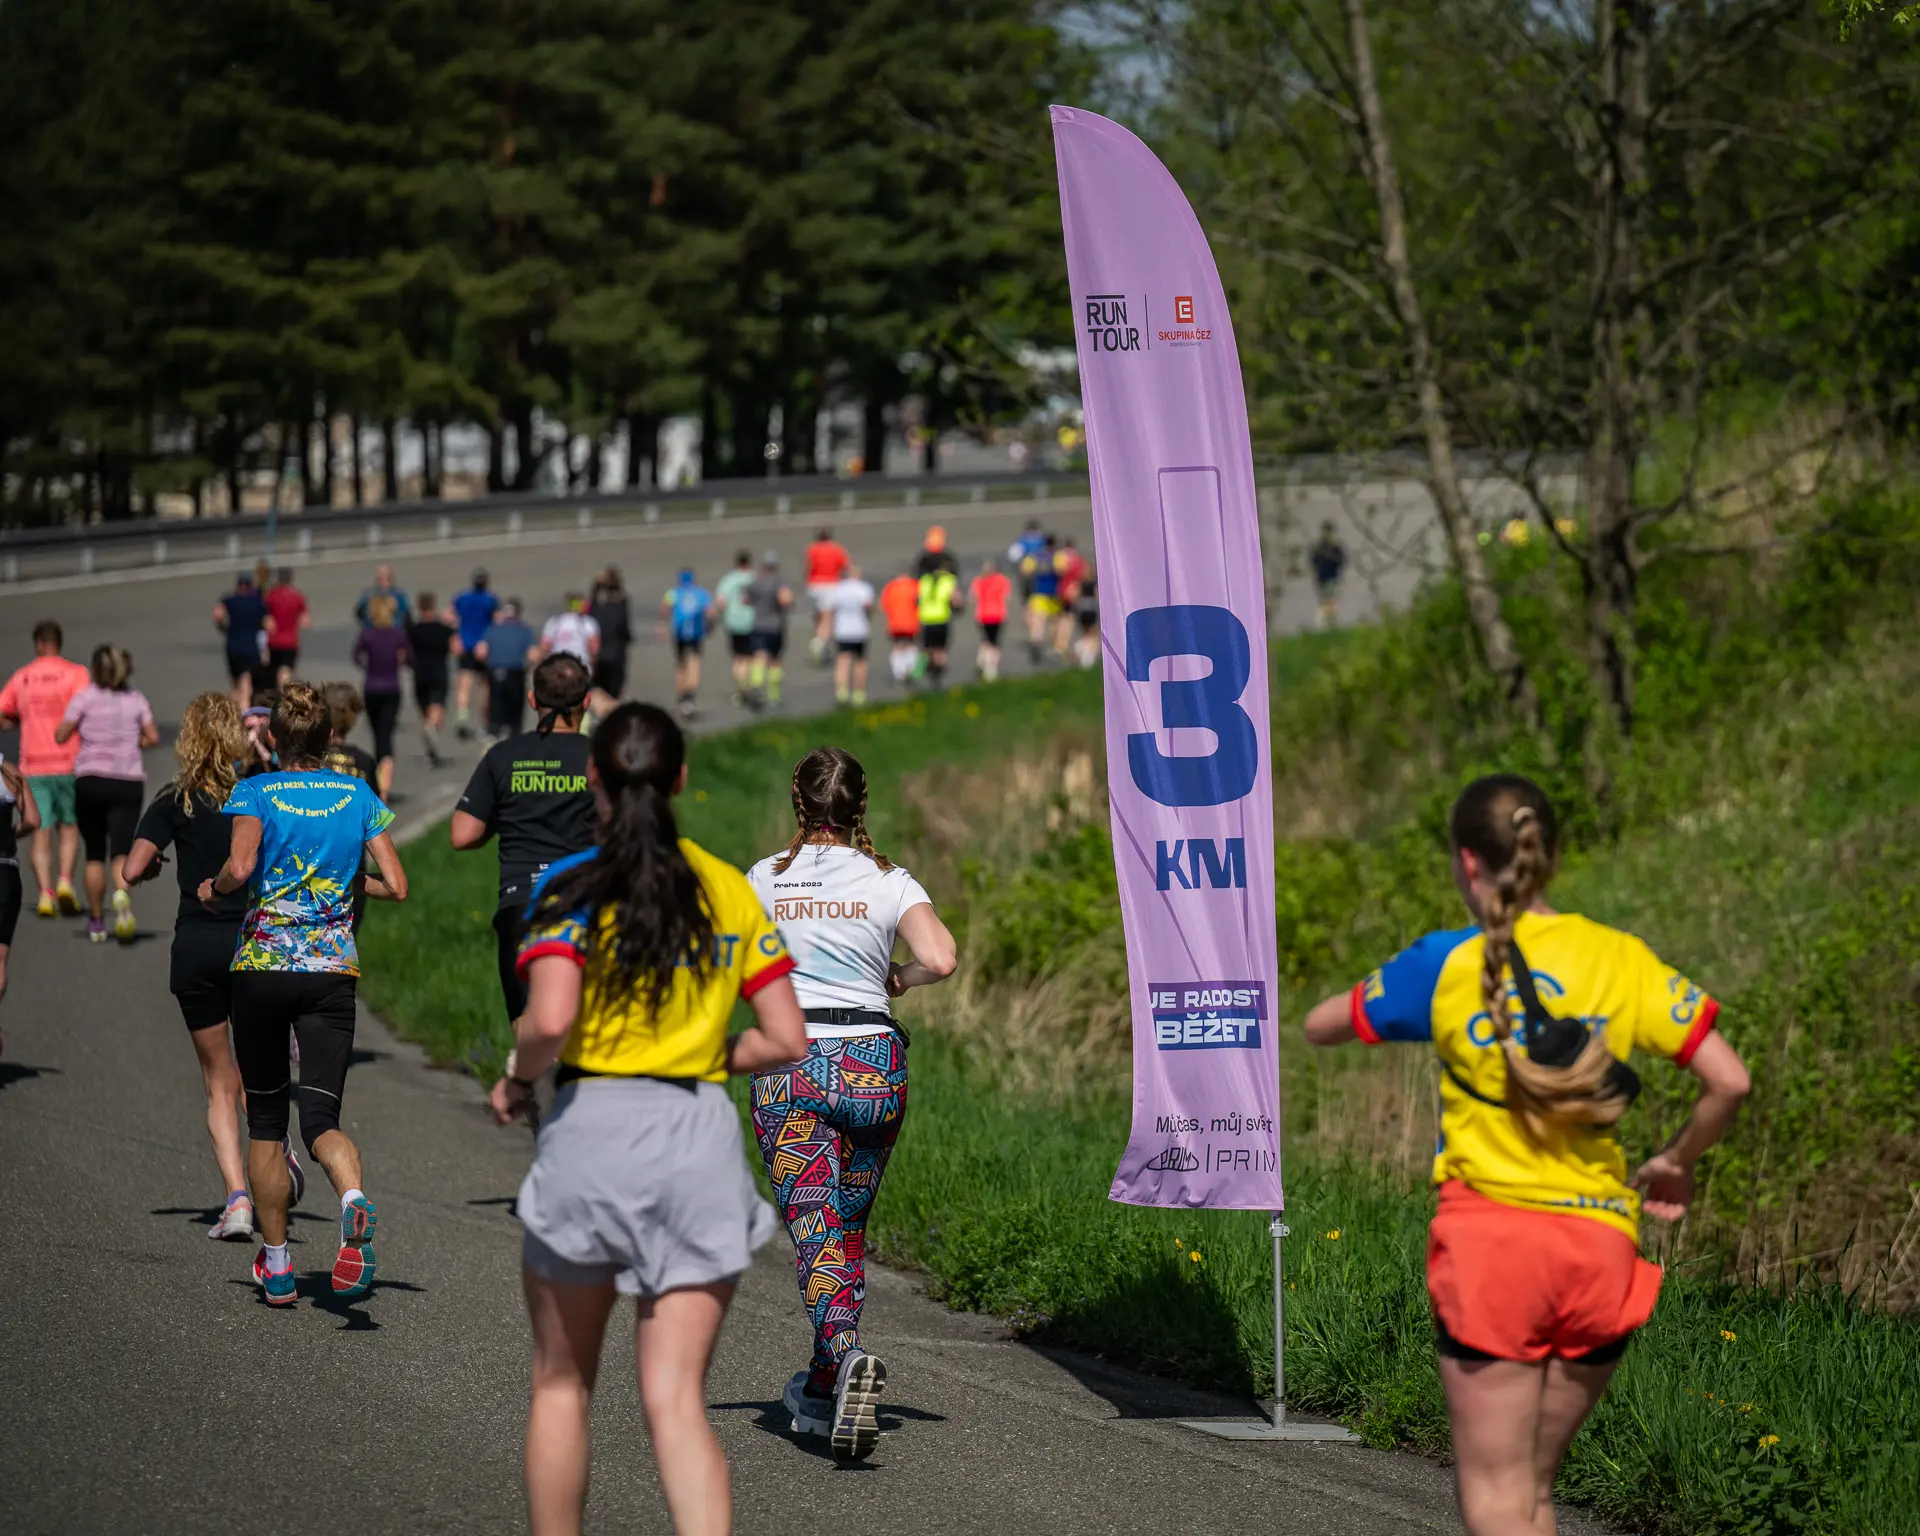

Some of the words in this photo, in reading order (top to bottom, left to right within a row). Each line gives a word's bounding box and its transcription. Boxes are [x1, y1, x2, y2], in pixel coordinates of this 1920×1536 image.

[1086, 302, 1128, 326] RUN
[1088, 328, 1140, 351] TOUR
[1126, 604, 1258, 807] 3
[307, 781, 326, 789] TAK
[511, 775, 587, 793] RUNTOUR
[1156, 838, 1247, 891] KM
[774, 901, 868, 922] RUNTOUR
[1150, 991, 1177, 1009] JE
[1184, 989, 1260, 1008] RADOST
[1155, 1010, 1256, 1045] BĚŽET
[1210, 1111, 1242, 1136] můj
[1246, 1114, 1273, 1133] svět
